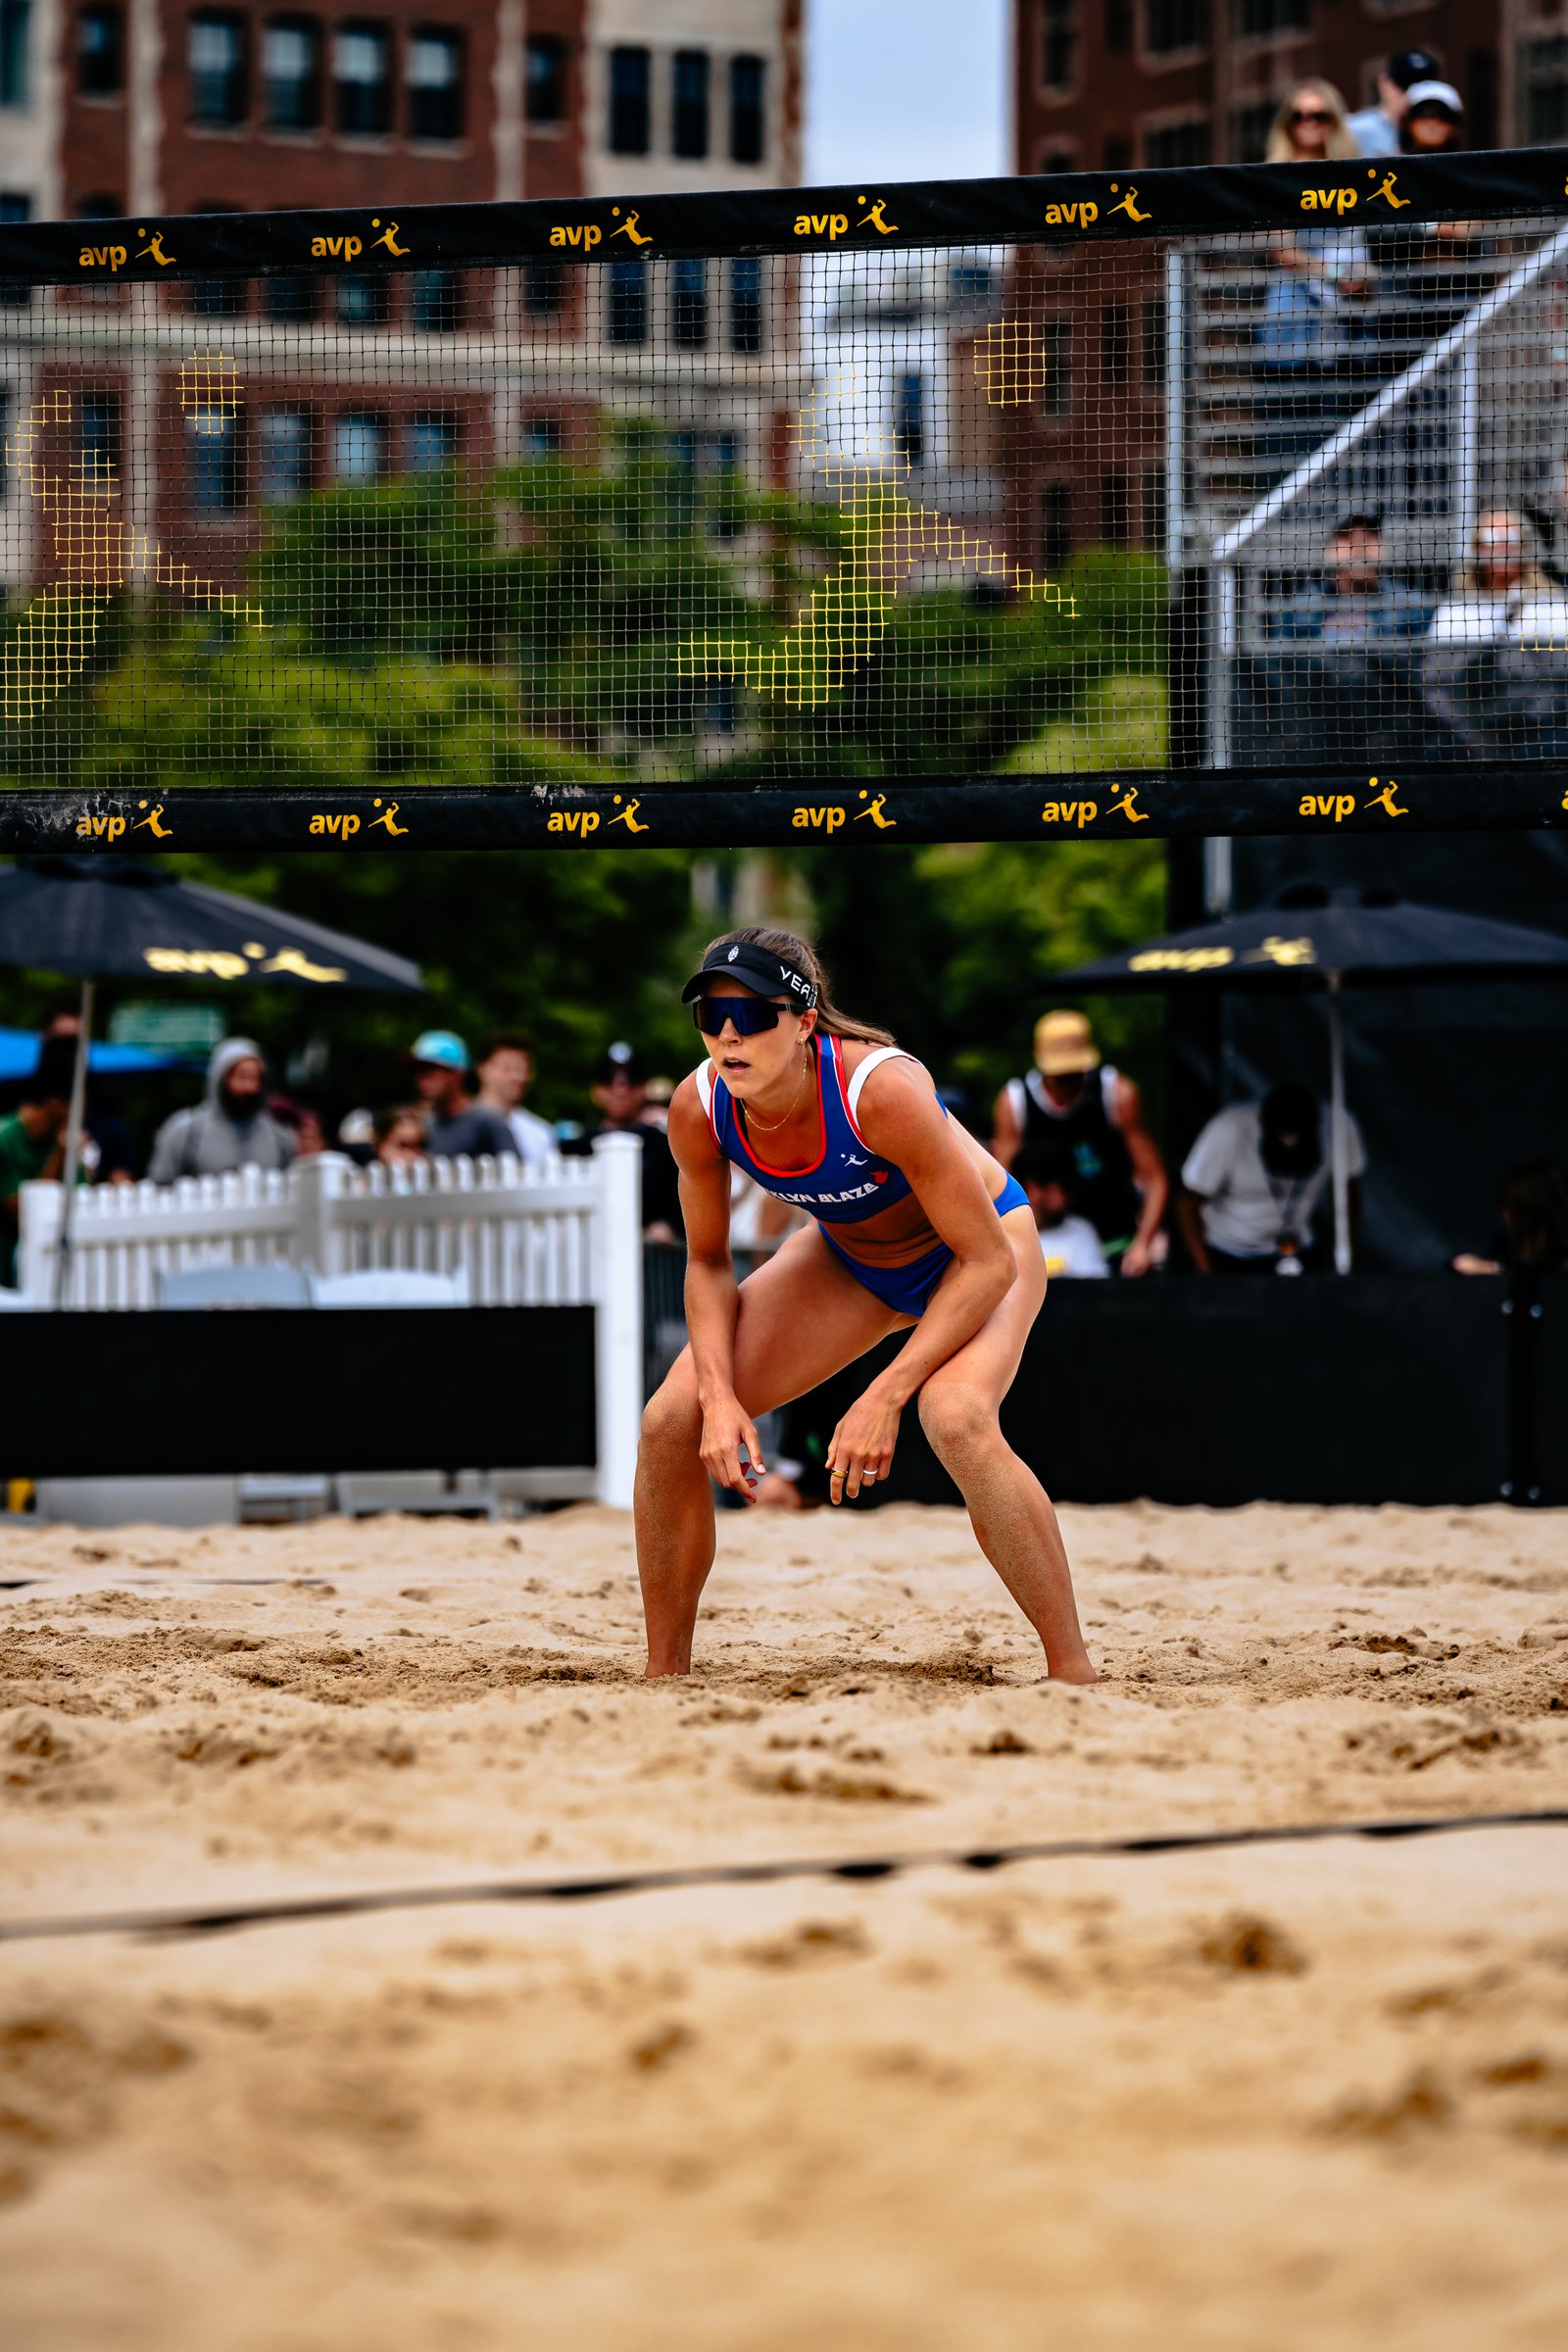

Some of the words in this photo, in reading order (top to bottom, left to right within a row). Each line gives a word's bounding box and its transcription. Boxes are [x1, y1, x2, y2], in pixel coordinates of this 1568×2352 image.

[1045, 201, 1099, 229] avp
[1299, 187, 1358, 216] avp
[549, 224, 602, 252] avp
[793, 214, 849, 241] avp
[78, 245, 127, 272] avp
[311, 235, 363, 263] avp
[791, 807, 846, 834] avp
[1042, 801, 1098, 829] avp
[1298, 795, 1356, 823] avp
[75, 816, 126, 843] avp
[309, 814, 361, 841] avp
[547, 811, 601, 838] avp
[817, 1182, 880, 1203] BLAZE
